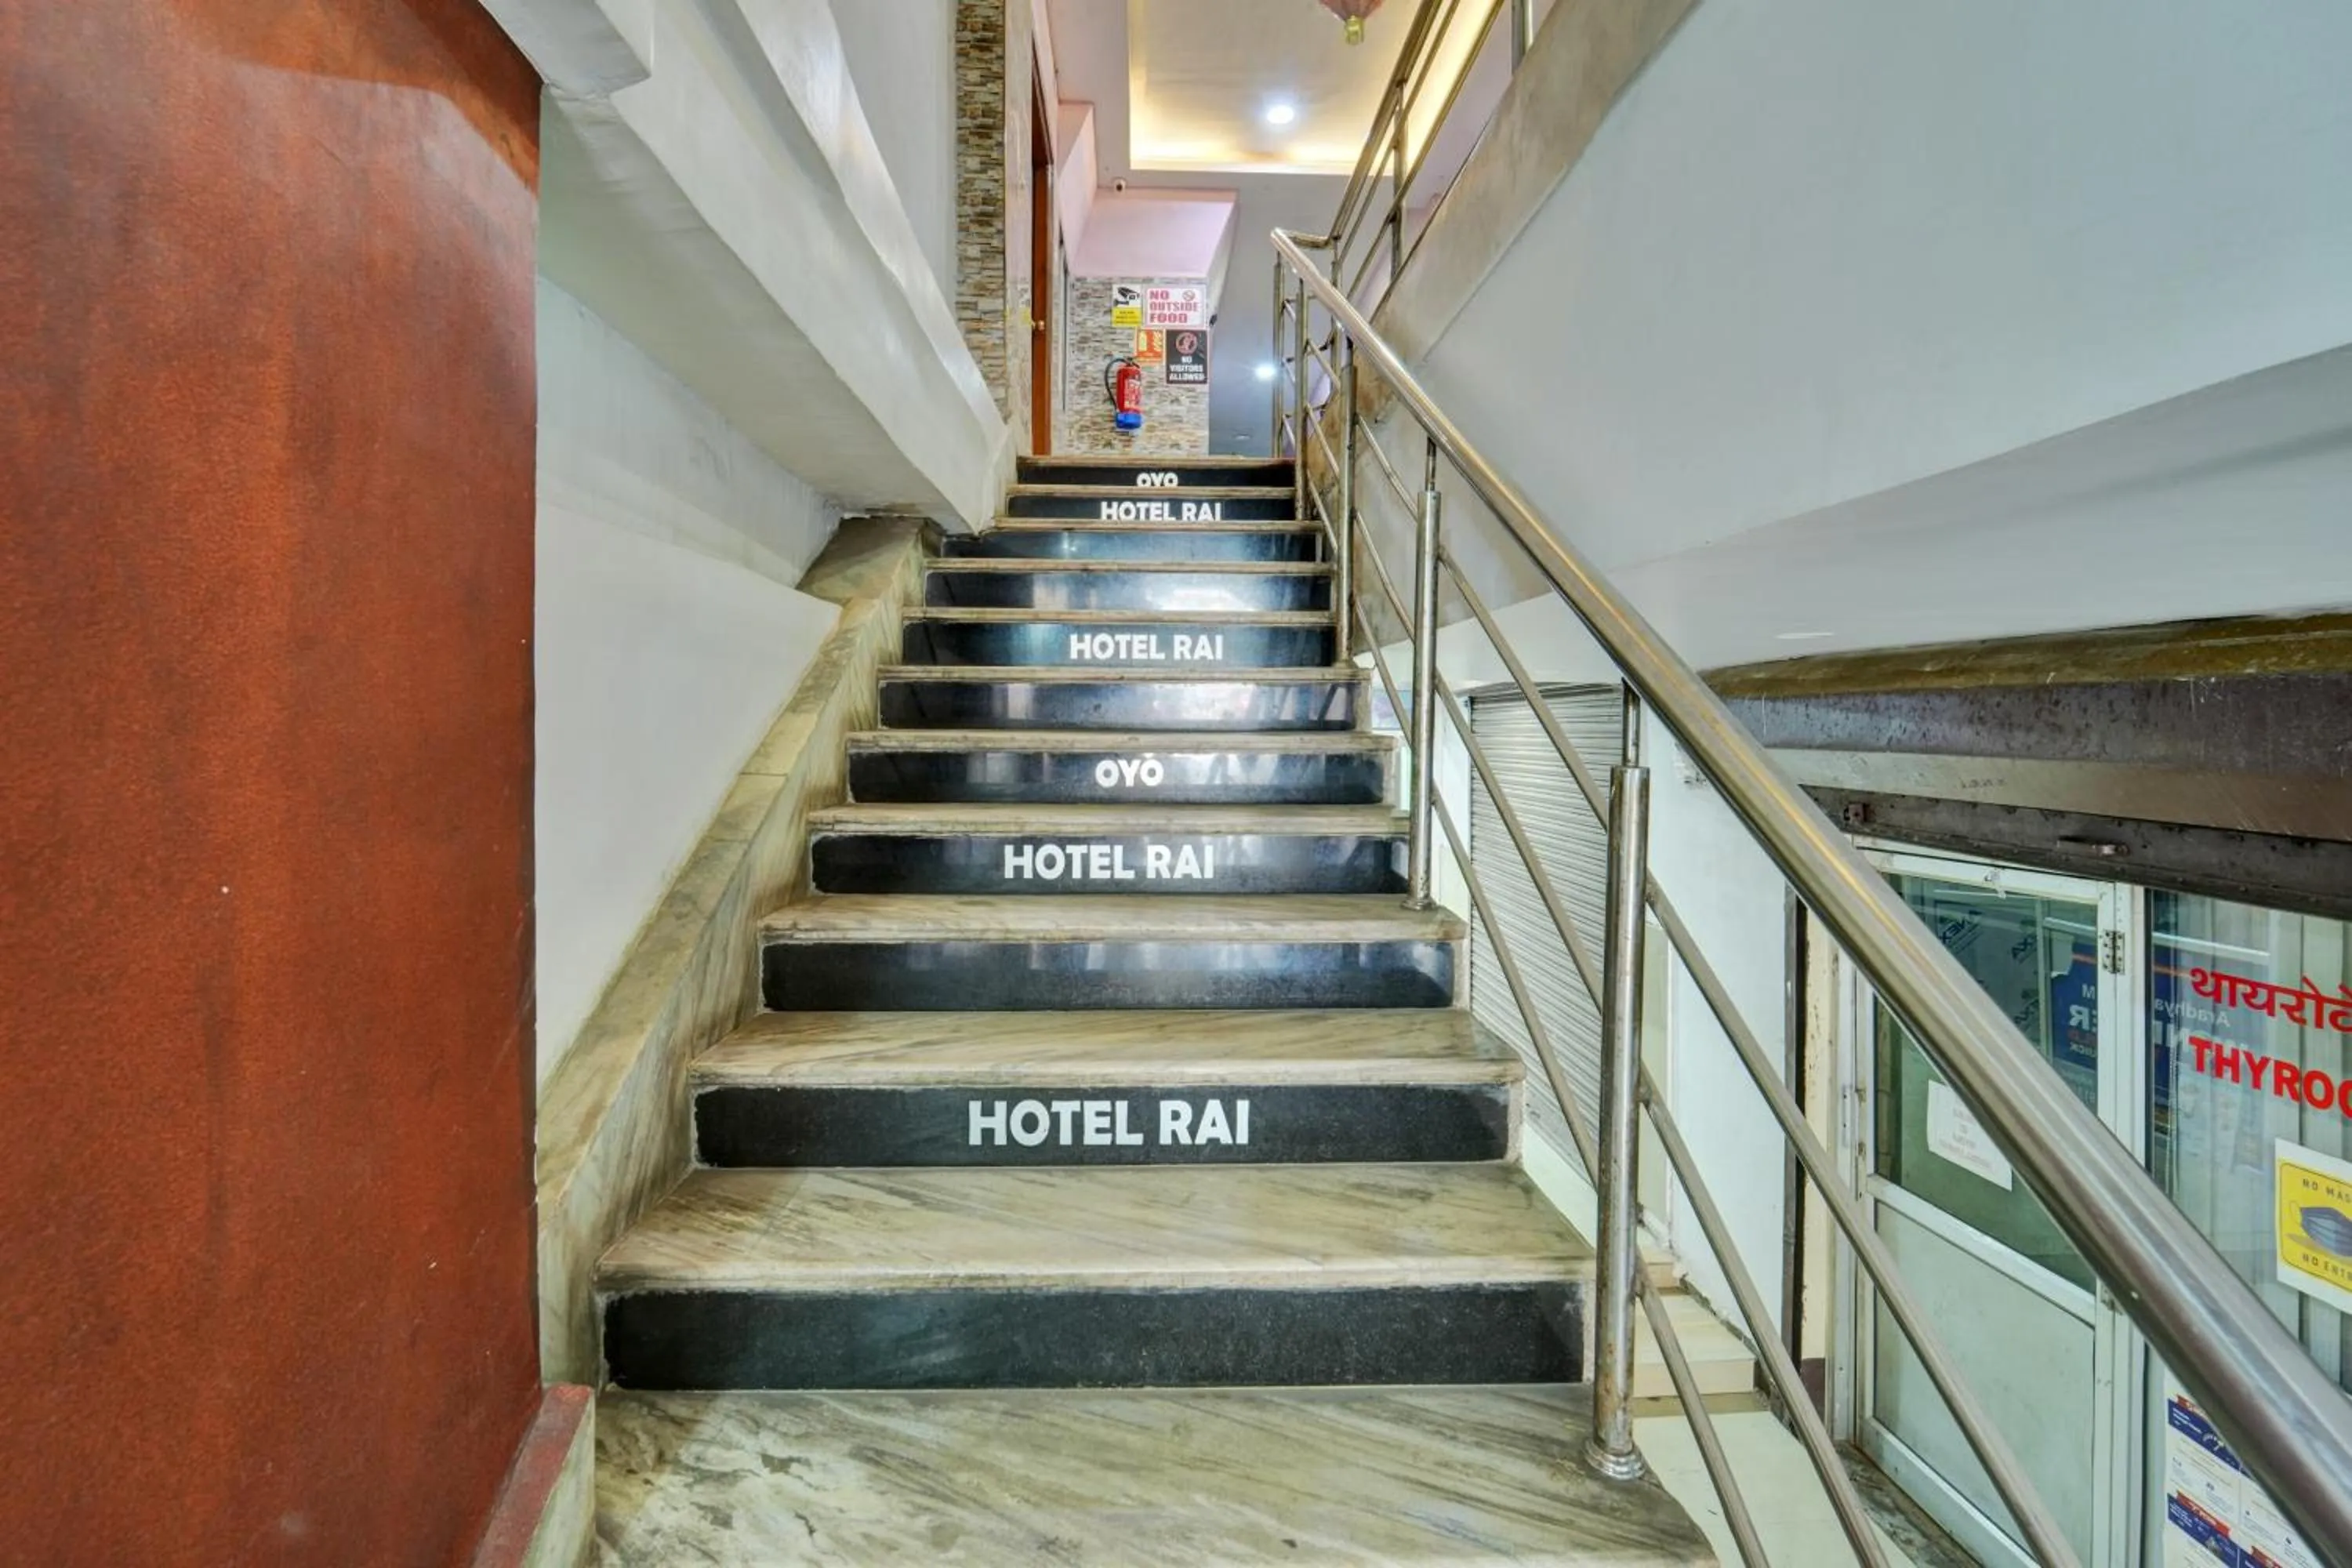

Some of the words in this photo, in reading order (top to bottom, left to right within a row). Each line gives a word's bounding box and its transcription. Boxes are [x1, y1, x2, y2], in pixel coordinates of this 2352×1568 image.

[1149, 290, 1169, 299] NO
[1149, 302, 1199, 312] OUTSIDE
[1149, 313, 1188, 323] FOOD
[1137, 472, 1178, 487] OYO
[1101, 501, 1176, 521] HOTEL
[1181, 502, 1221, 521] RAI
[1070, 633, 1166, 659] HOTEL
[1174, 634, 1224, 660] RAI
[1095, 759, 1163, 788] OYO
[1004, 844, 1134, 880] HOTEL
[1146, 844, 1214, 879] RAI
[968, 1099, 1144, 1146] HOTEL
[1160, 1099, 1250, 1145] RAI
[2303, 1178, 2318, 1191] NO
[2302, 1254, 2318, 1266] NO
